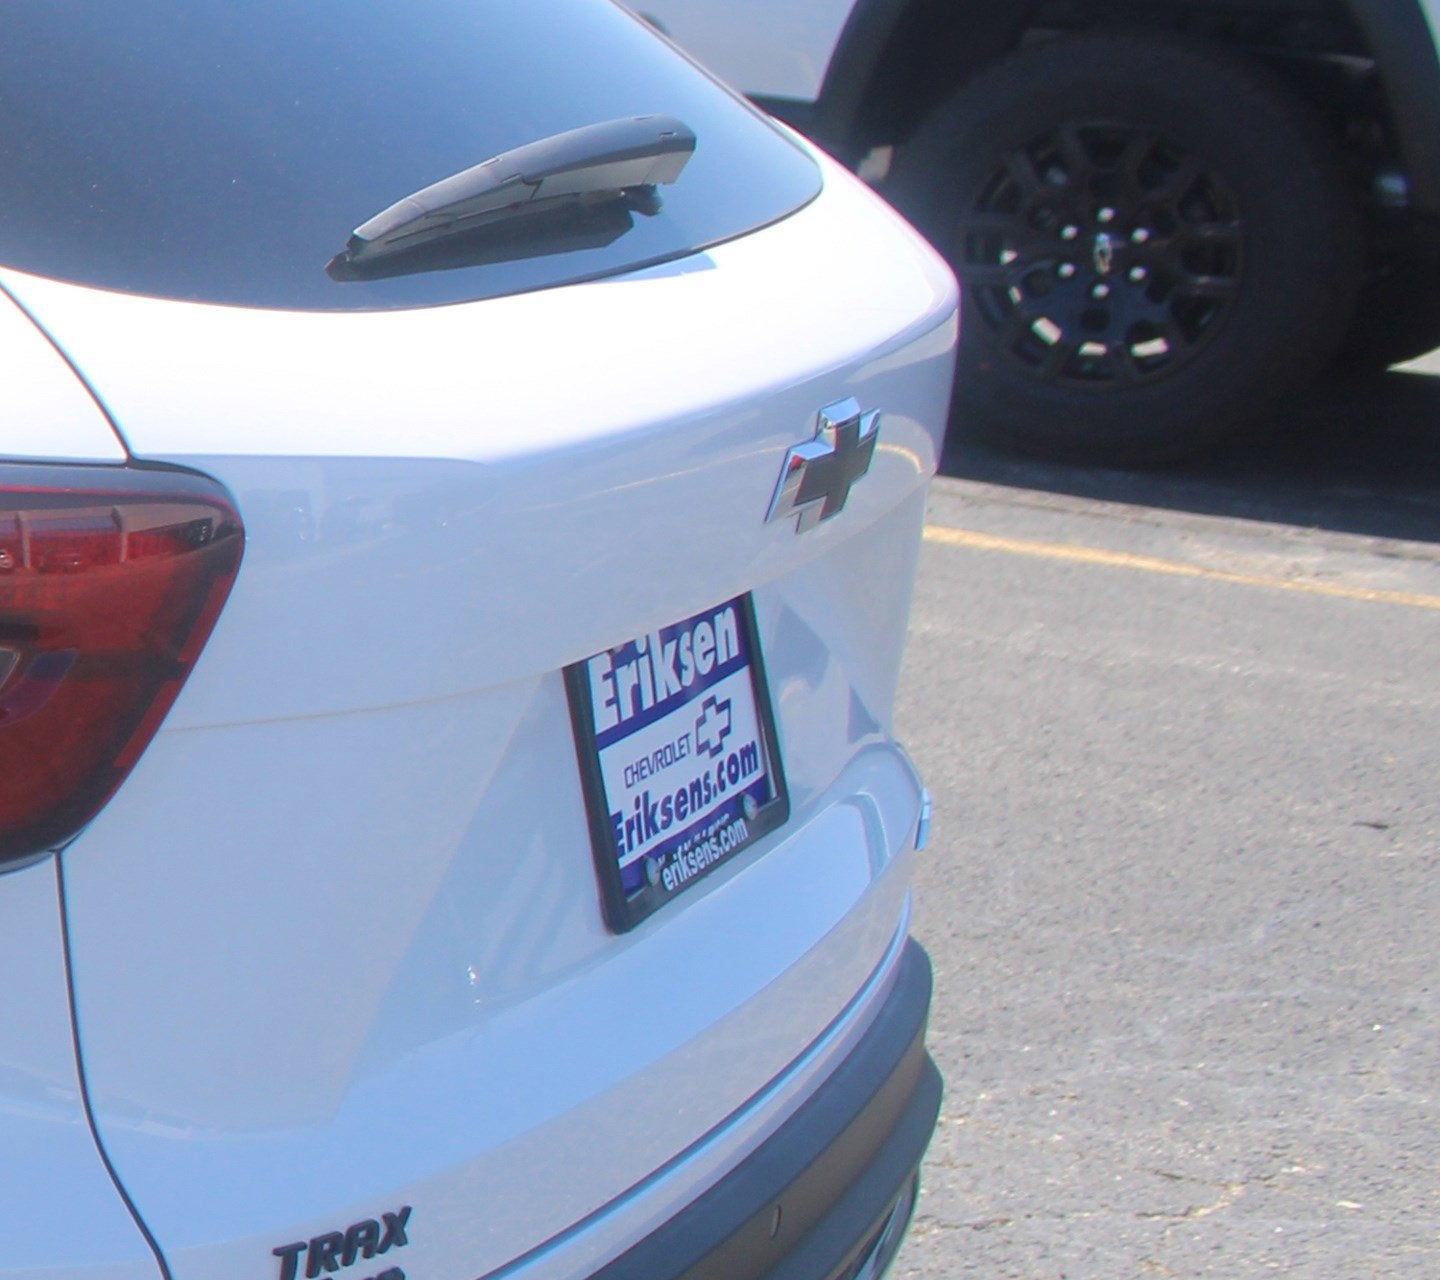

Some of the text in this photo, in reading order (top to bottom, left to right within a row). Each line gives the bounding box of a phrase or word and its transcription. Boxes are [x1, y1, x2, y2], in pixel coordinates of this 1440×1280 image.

[587, 605, 740, 736] Eriksen
[609, 739, 759, 860] Eriksens.com
[623, 732, 693, 789] CHEVROLET
[661, 817, 750, 892] eriksens.com
